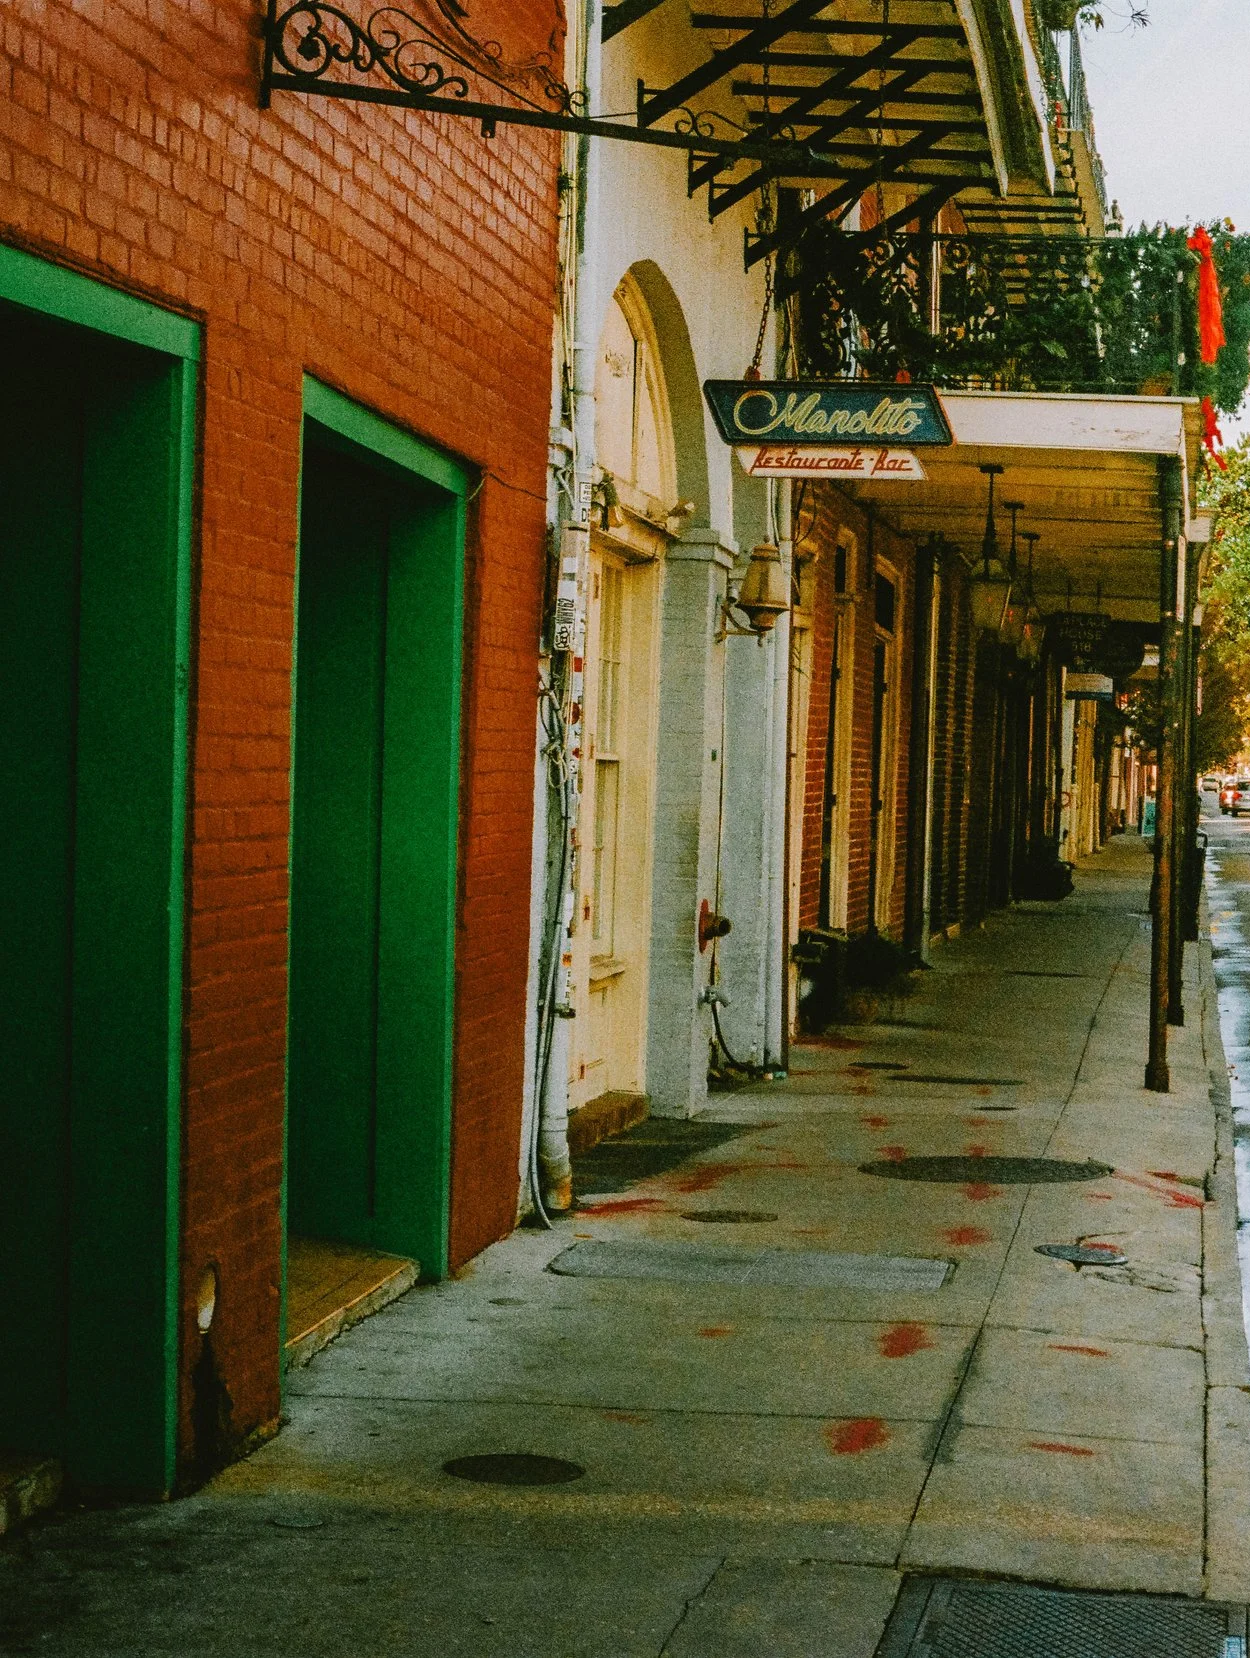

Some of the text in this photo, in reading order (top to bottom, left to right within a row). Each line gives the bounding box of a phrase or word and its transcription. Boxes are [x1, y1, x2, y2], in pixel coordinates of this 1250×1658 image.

[733, 389, 925, 435] Manolito
[871, 450, 913, 475] Bar
[1059, 627, 1103, 640] HOUSE
